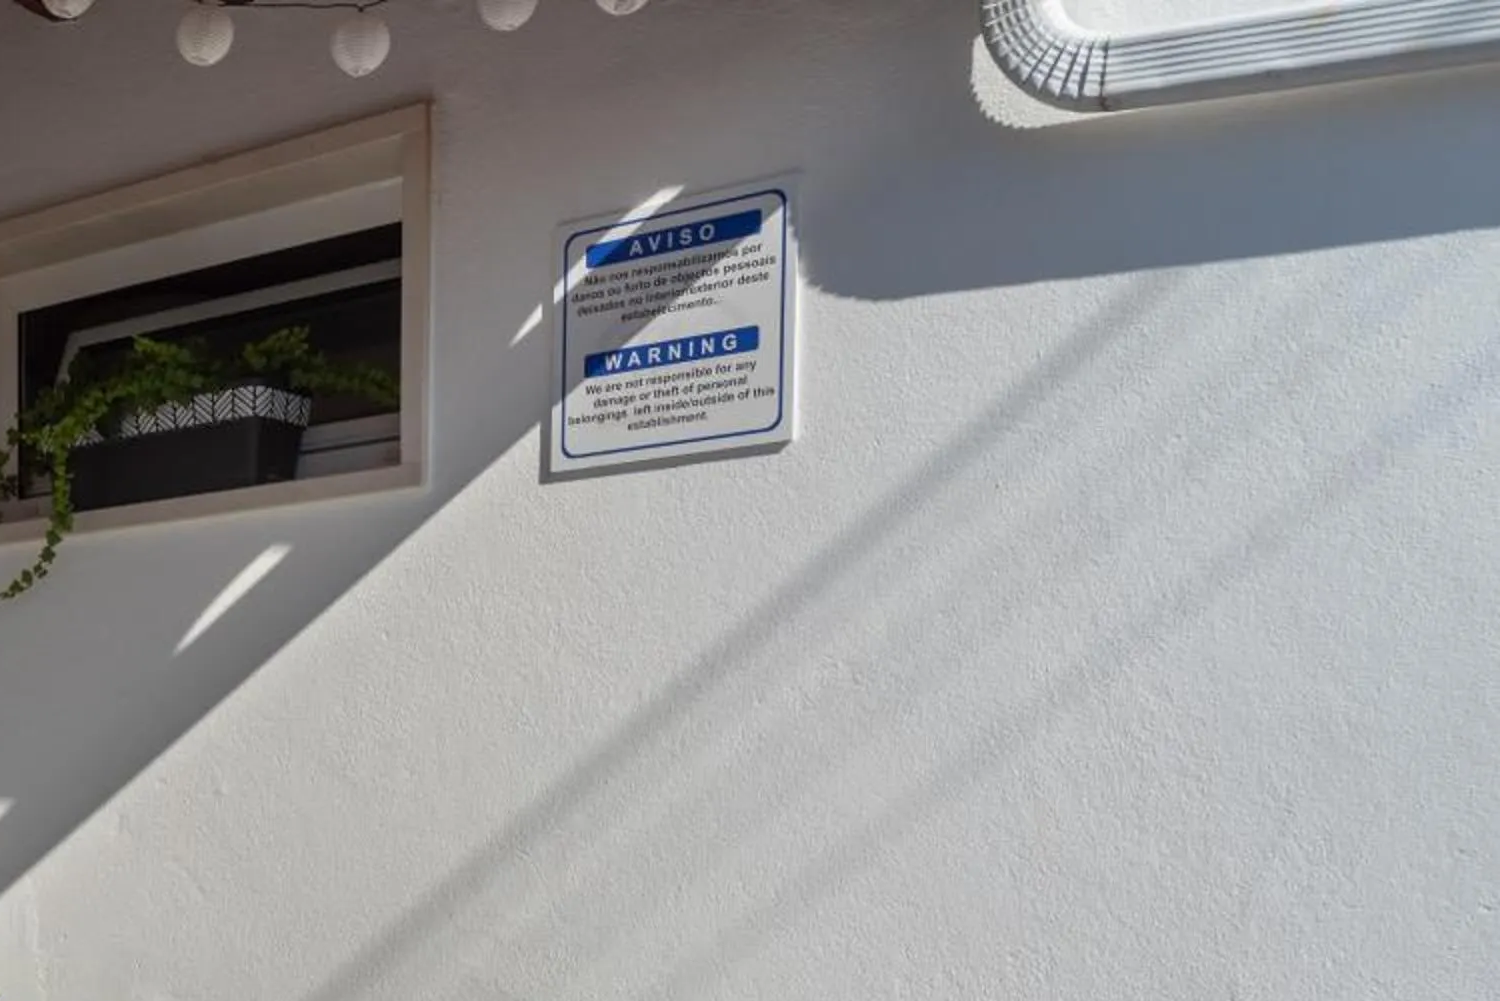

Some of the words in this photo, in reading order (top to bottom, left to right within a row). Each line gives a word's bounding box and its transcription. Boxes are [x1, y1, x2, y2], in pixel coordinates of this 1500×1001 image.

[629, 223, 716, 256] AVISO
[741, 243, 763, 256] por
[653, 275, 667, 287] de
[723, 254, 777, 276] pessoais
[738, 271, 770, 286] deste
[605, 333, 738, 371] WARNING
[585, 384, 602, 395] We
[605, 382, 622, 392] are
[625, 378, 643, 390] not
[645, 366, 712, 387] responsible
[715, 363, 731, 375] for
[735, 360, 756, 372] any
[593, 395, 636, 409] damage
[638, 392, 651, 401] or
[653, 385, 679, 399] theft
[682, 382, 693, 395] of
[696, 374, 748, 393] personal
[633, 403, 651, 416] left
[737, 388, 750, 400] of
[753, 386, 775, 399] this
